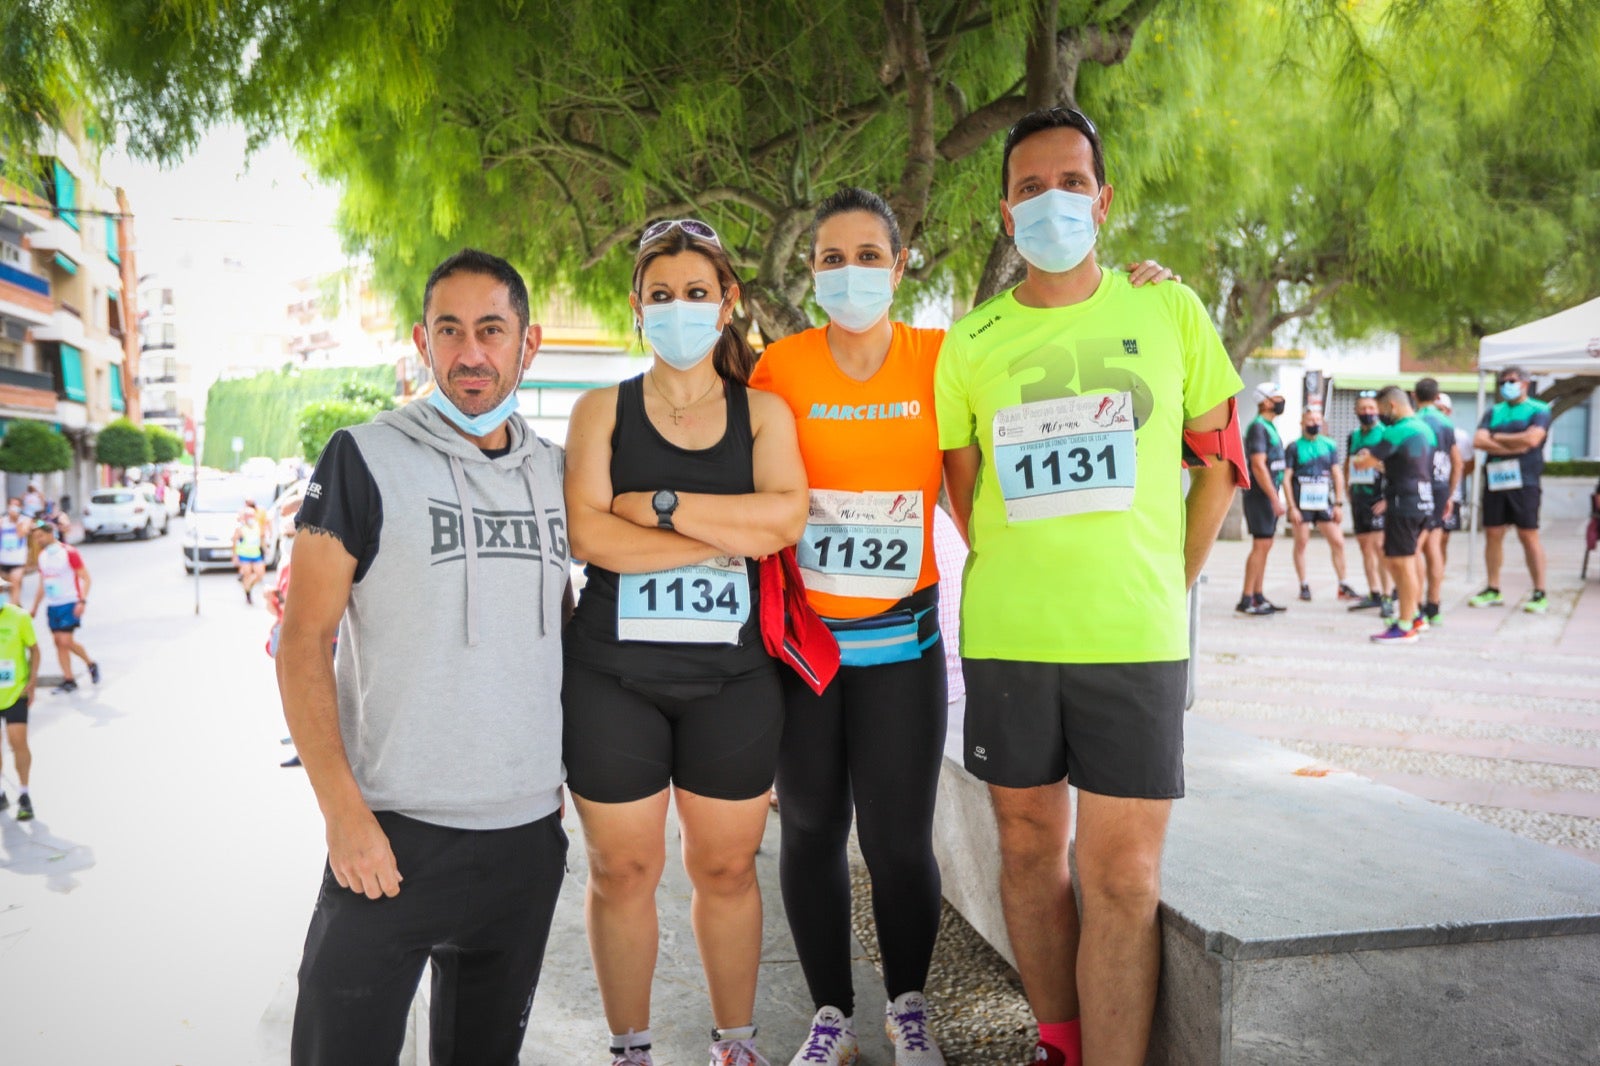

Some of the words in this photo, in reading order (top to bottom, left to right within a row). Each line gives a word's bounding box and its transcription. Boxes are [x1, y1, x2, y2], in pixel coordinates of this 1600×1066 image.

[1015, 444, 1117, 490] 1131
[429, 506, 567, 561] BOXING
[813, 536, 908, 572] 1132
[639, 577, 740, 615] 1134
